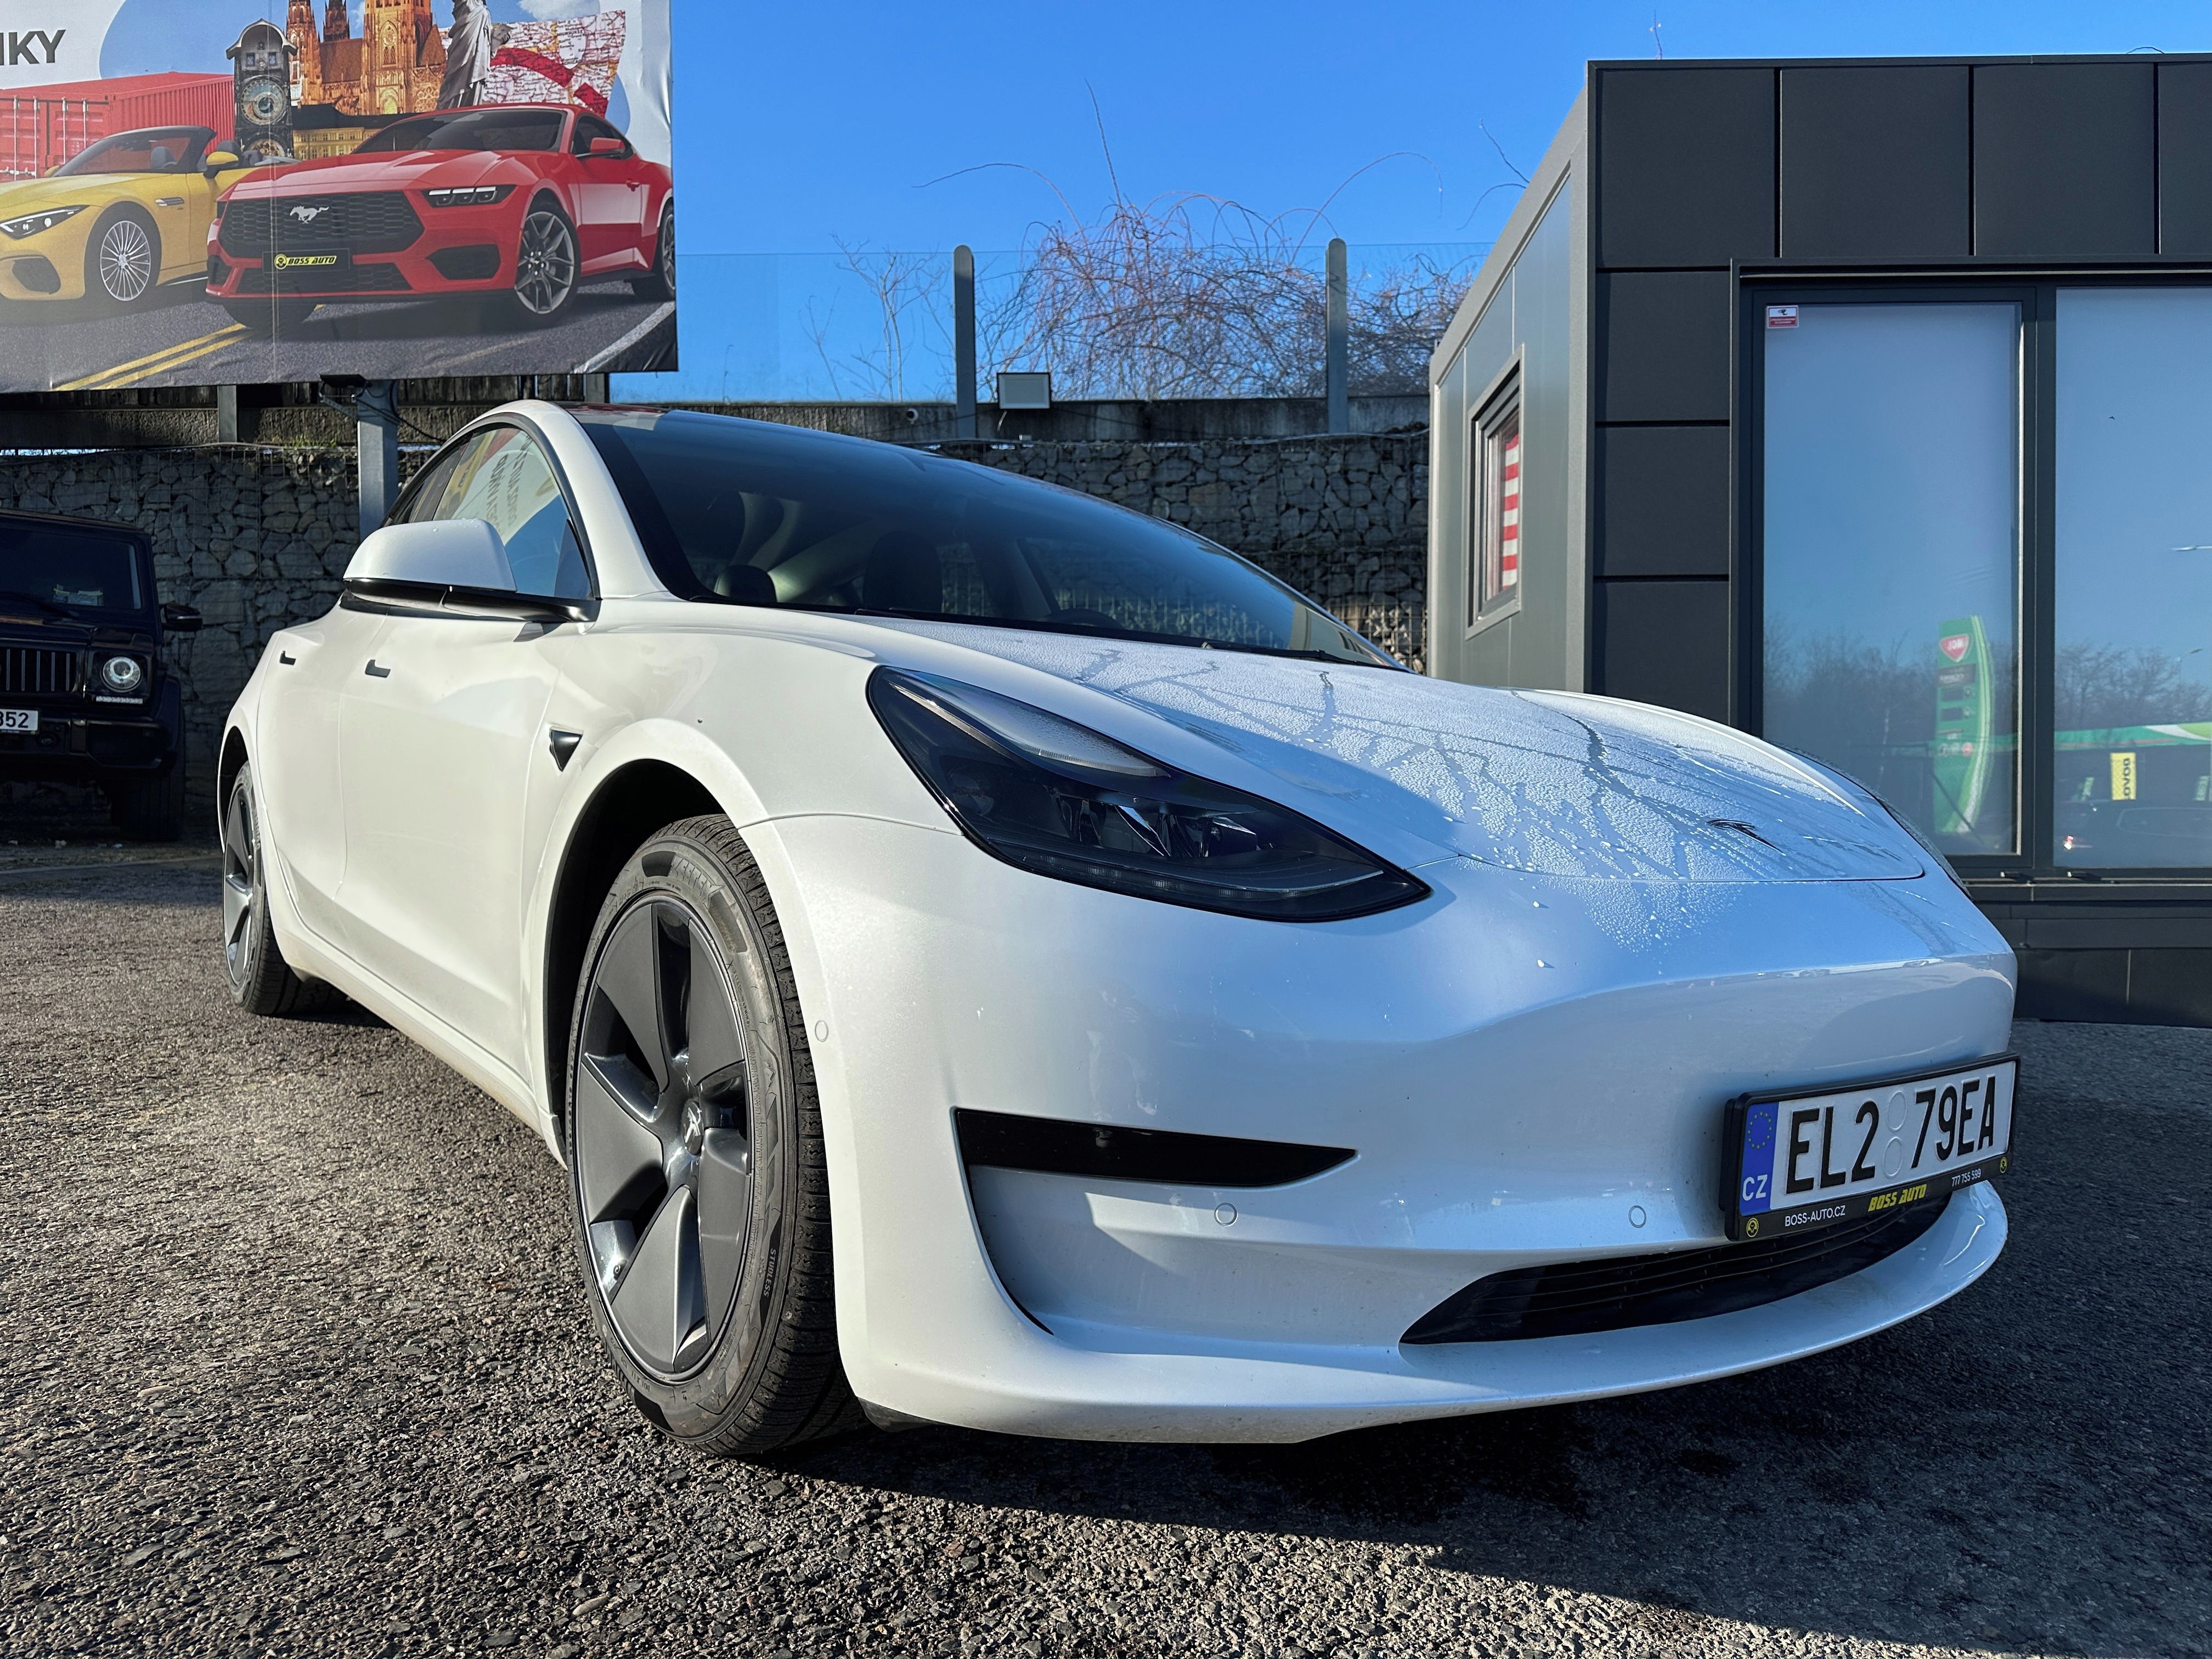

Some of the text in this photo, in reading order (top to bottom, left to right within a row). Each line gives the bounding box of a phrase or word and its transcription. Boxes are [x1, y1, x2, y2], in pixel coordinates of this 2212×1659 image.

[0, 29, 66, 65] KY
[1786, 1076, 1996, 1194] EL2 79EA
[1742, 1174, 1768, 1201] CZ
[1785, 1205, 1846, 1227] BOSS-AUTO.CZ
[1867, 1192, 1898, 1212] BOSS
[1899, 1184, 1927, 1204] AUTO
[1951, 1175, 1961, 1187] 777
[763, 1248, 776, 1297] STUDLESS
